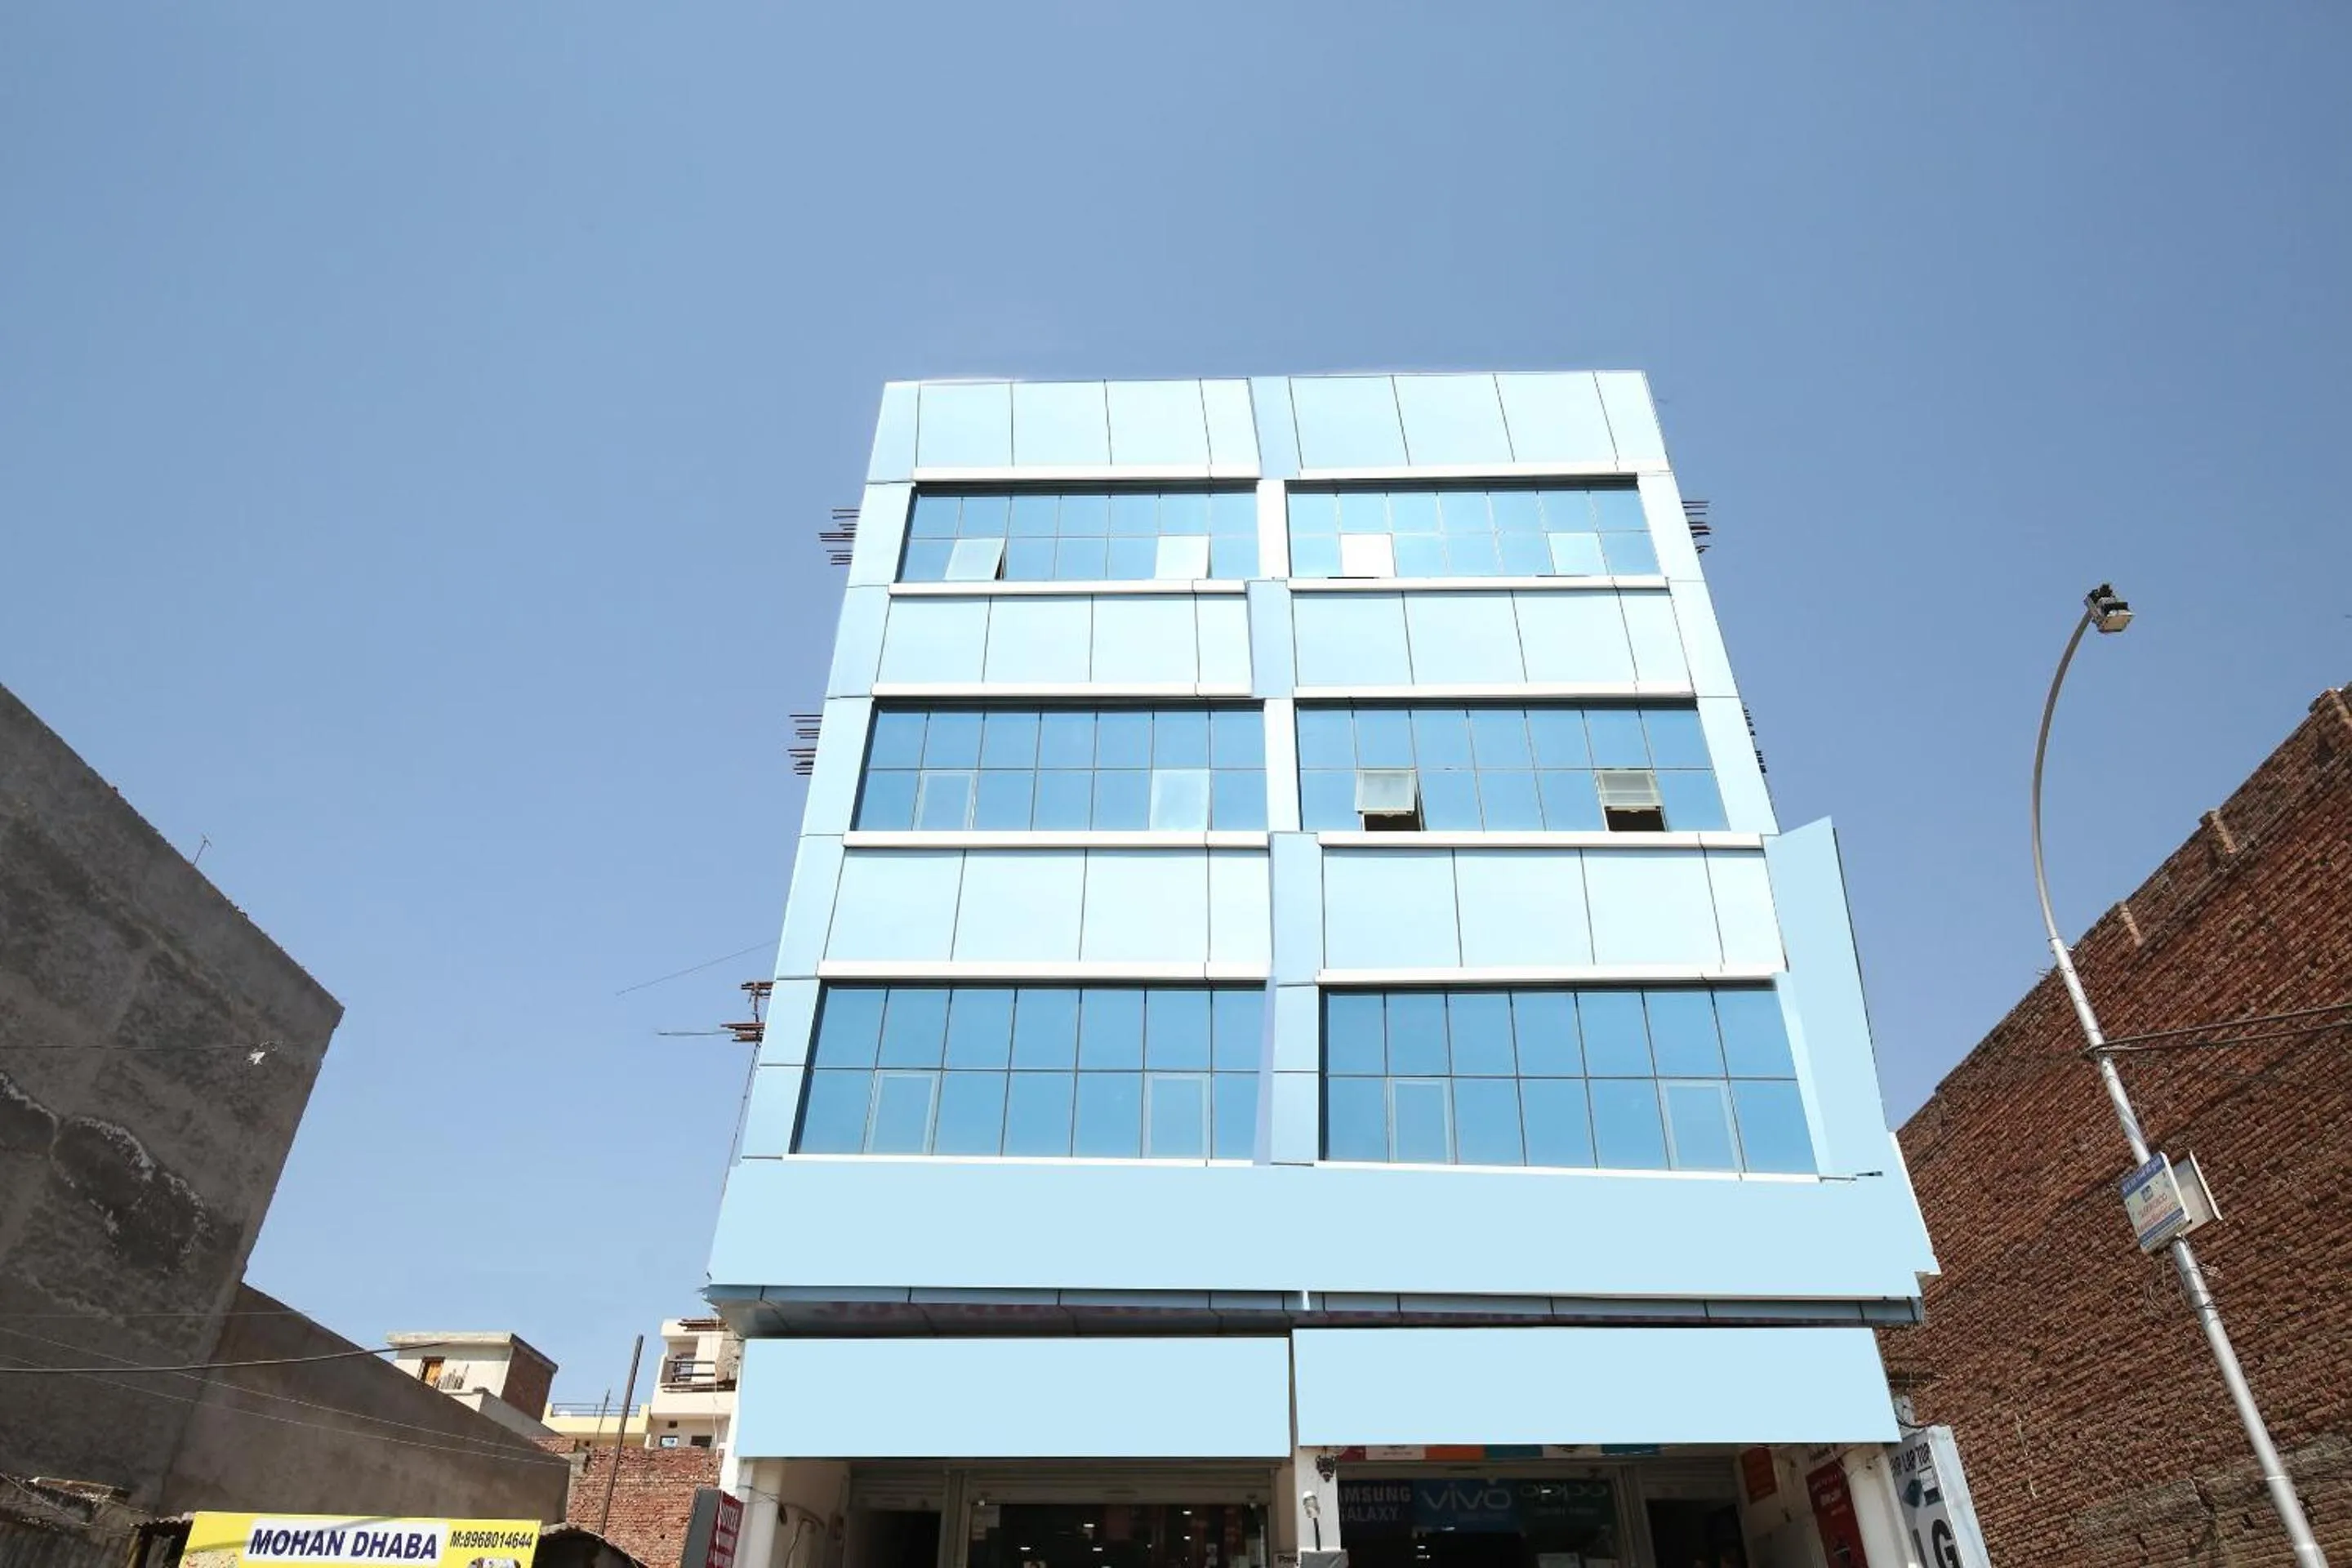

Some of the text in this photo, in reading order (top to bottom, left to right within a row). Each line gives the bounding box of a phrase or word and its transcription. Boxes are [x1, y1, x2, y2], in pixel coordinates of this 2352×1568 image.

[248, 1529, 437, 1559] MOHAN DHABA
[450, 1530, 534, 1549] M:8968014644
